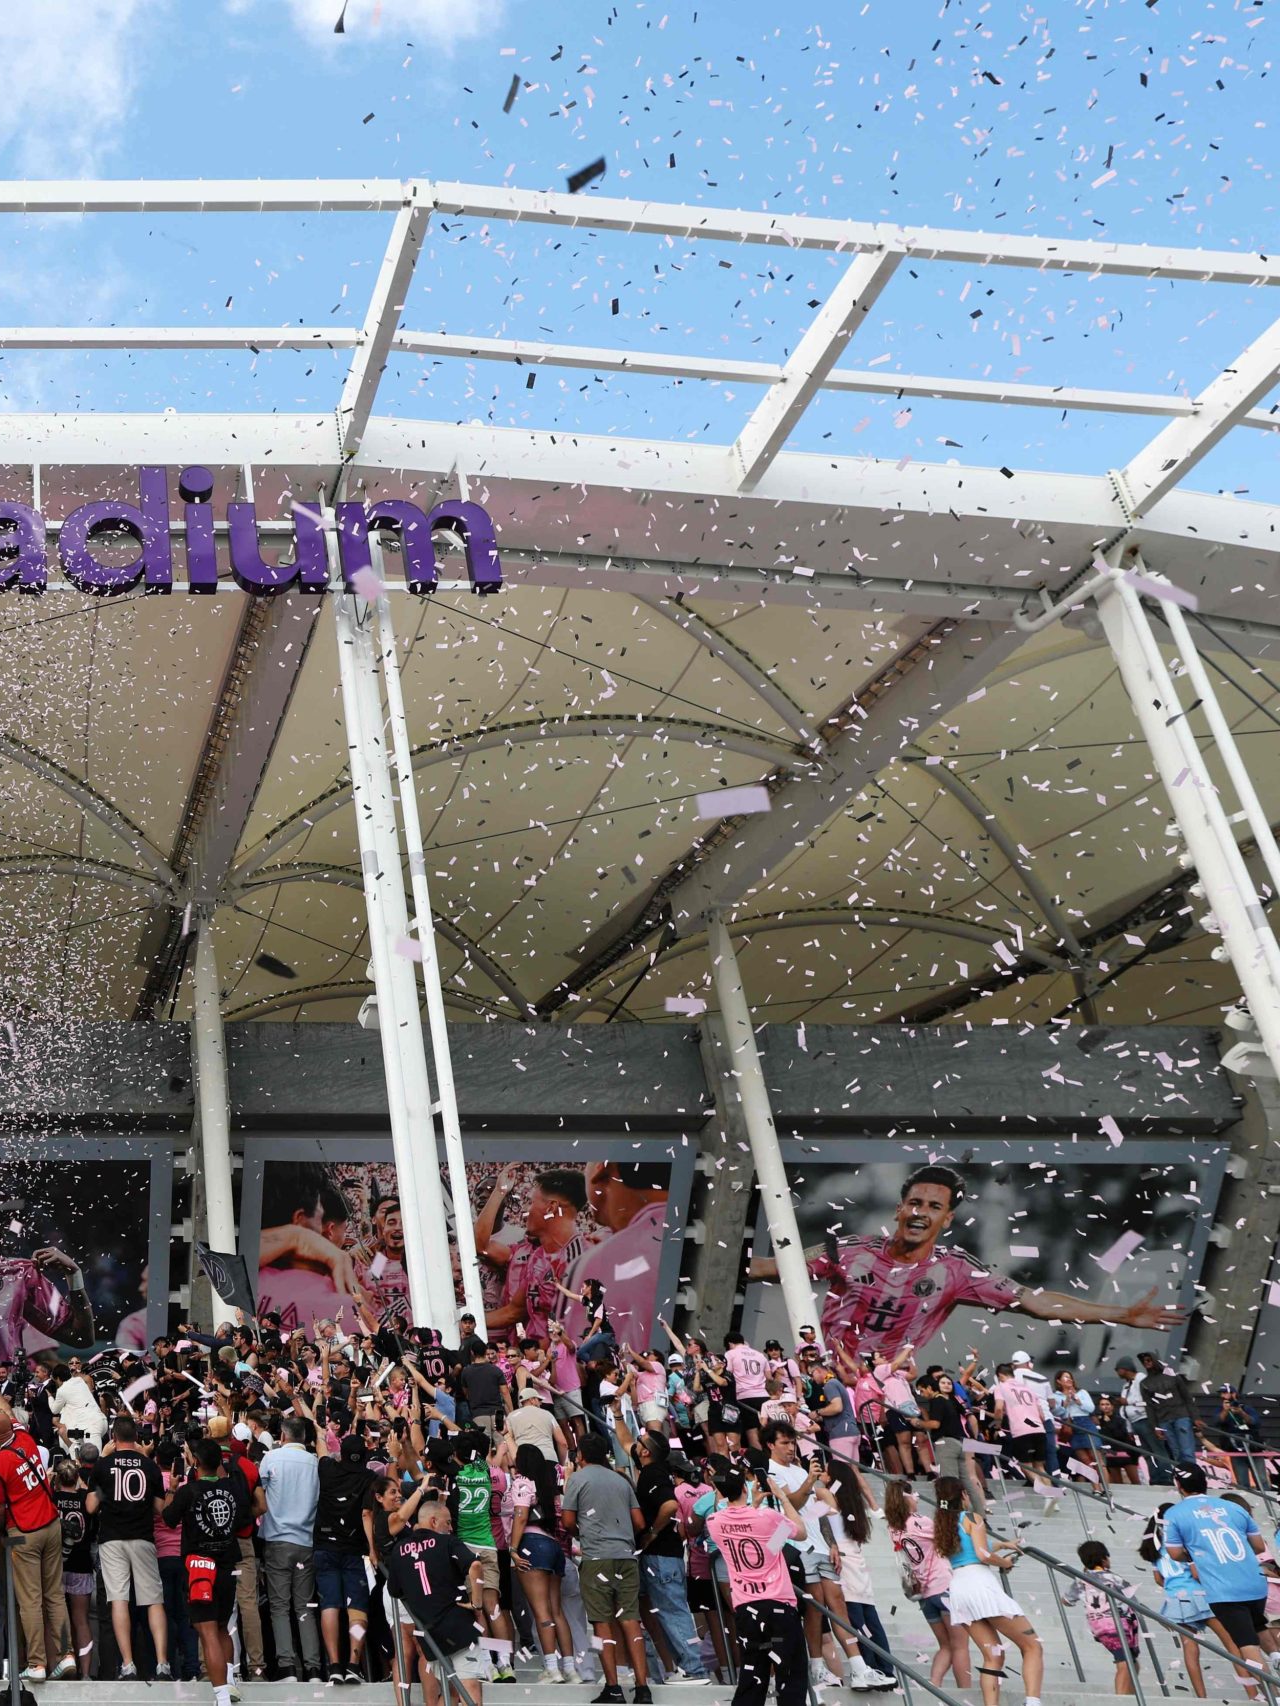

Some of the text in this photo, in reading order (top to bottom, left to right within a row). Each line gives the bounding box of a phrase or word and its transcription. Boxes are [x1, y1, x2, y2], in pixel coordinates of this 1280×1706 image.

[423, 1358, 445, 1378] 10
[741, 1358, 761, 1375] 10
[1010, 1388, 1033, 1406] 10
[114, 1458, 142, 1467] MESSI
[110, 1467, 147, 1502] 10
[57, 1500, 81, 1509] MESSI
[458, 1487, 490, 1514] 22
[721, 1523, 753, 1534] KARIM
[400, 1538, 436, 1557] LOBATO
[723, 1537, 765, 1572] 10
[1200, 1527, 1246, 1565] 10
[414, 1561, 432, 1596] 1
